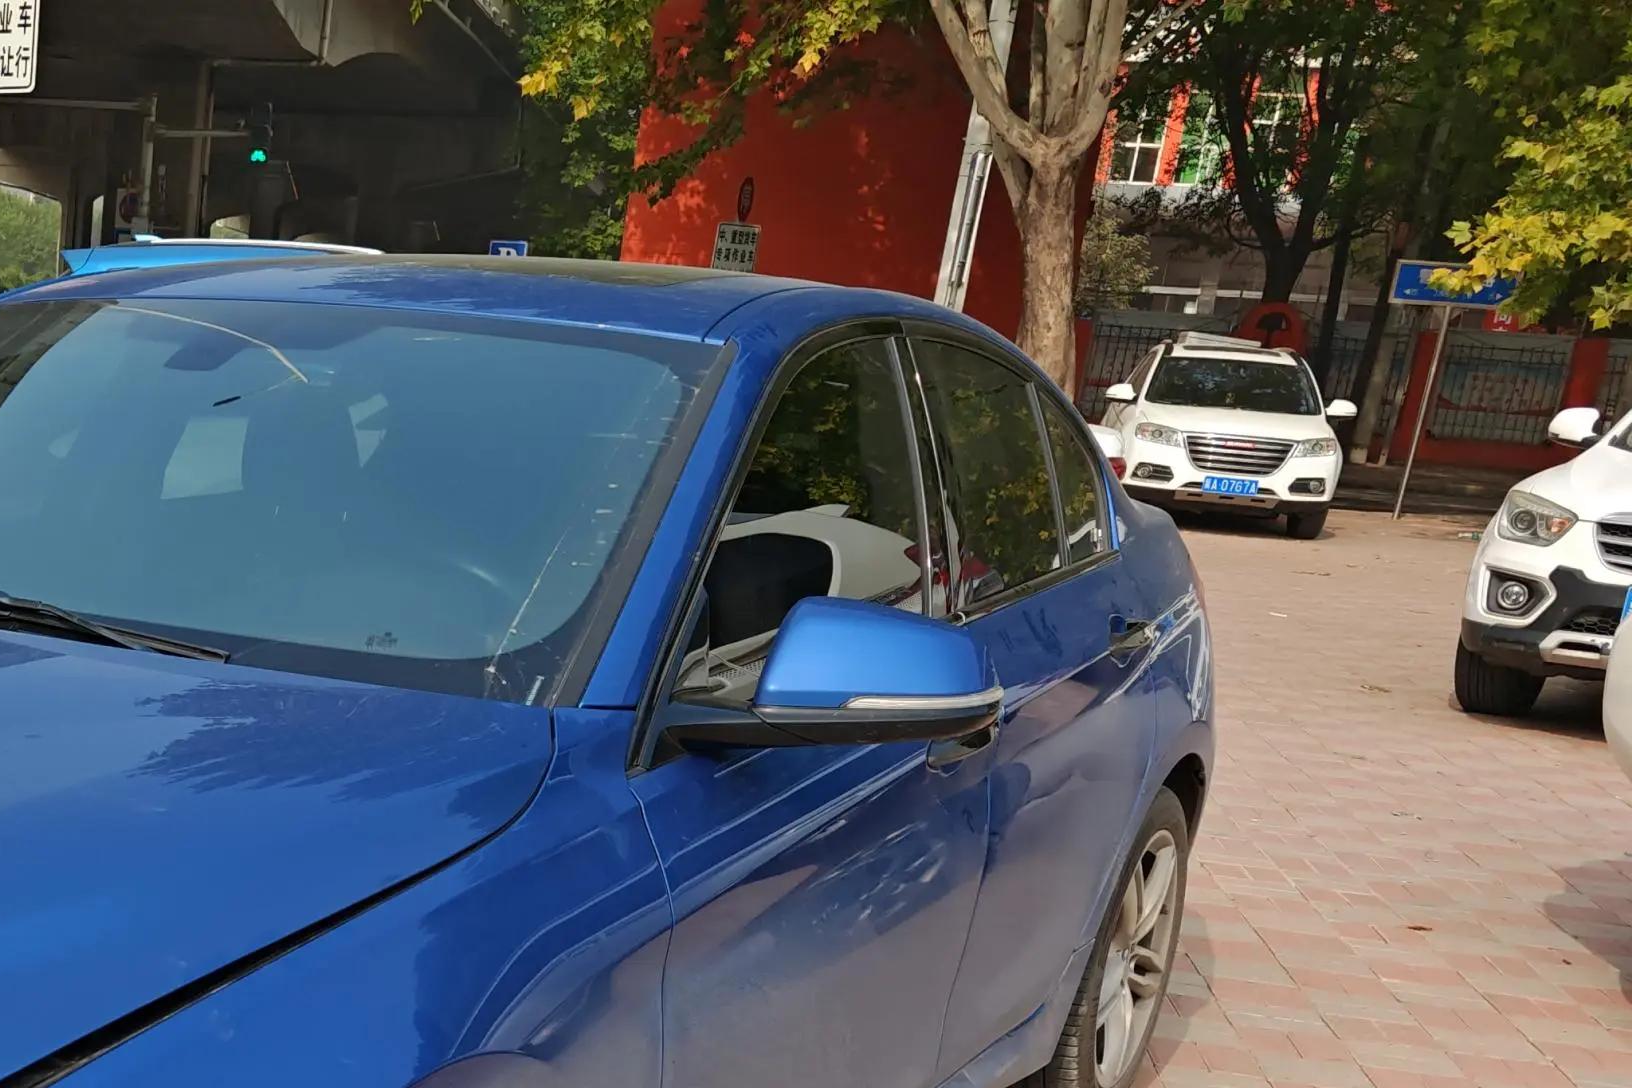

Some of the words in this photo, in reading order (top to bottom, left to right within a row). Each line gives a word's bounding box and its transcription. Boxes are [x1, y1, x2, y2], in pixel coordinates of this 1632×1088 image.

[715, 250, 754, 264] 专项作业车
